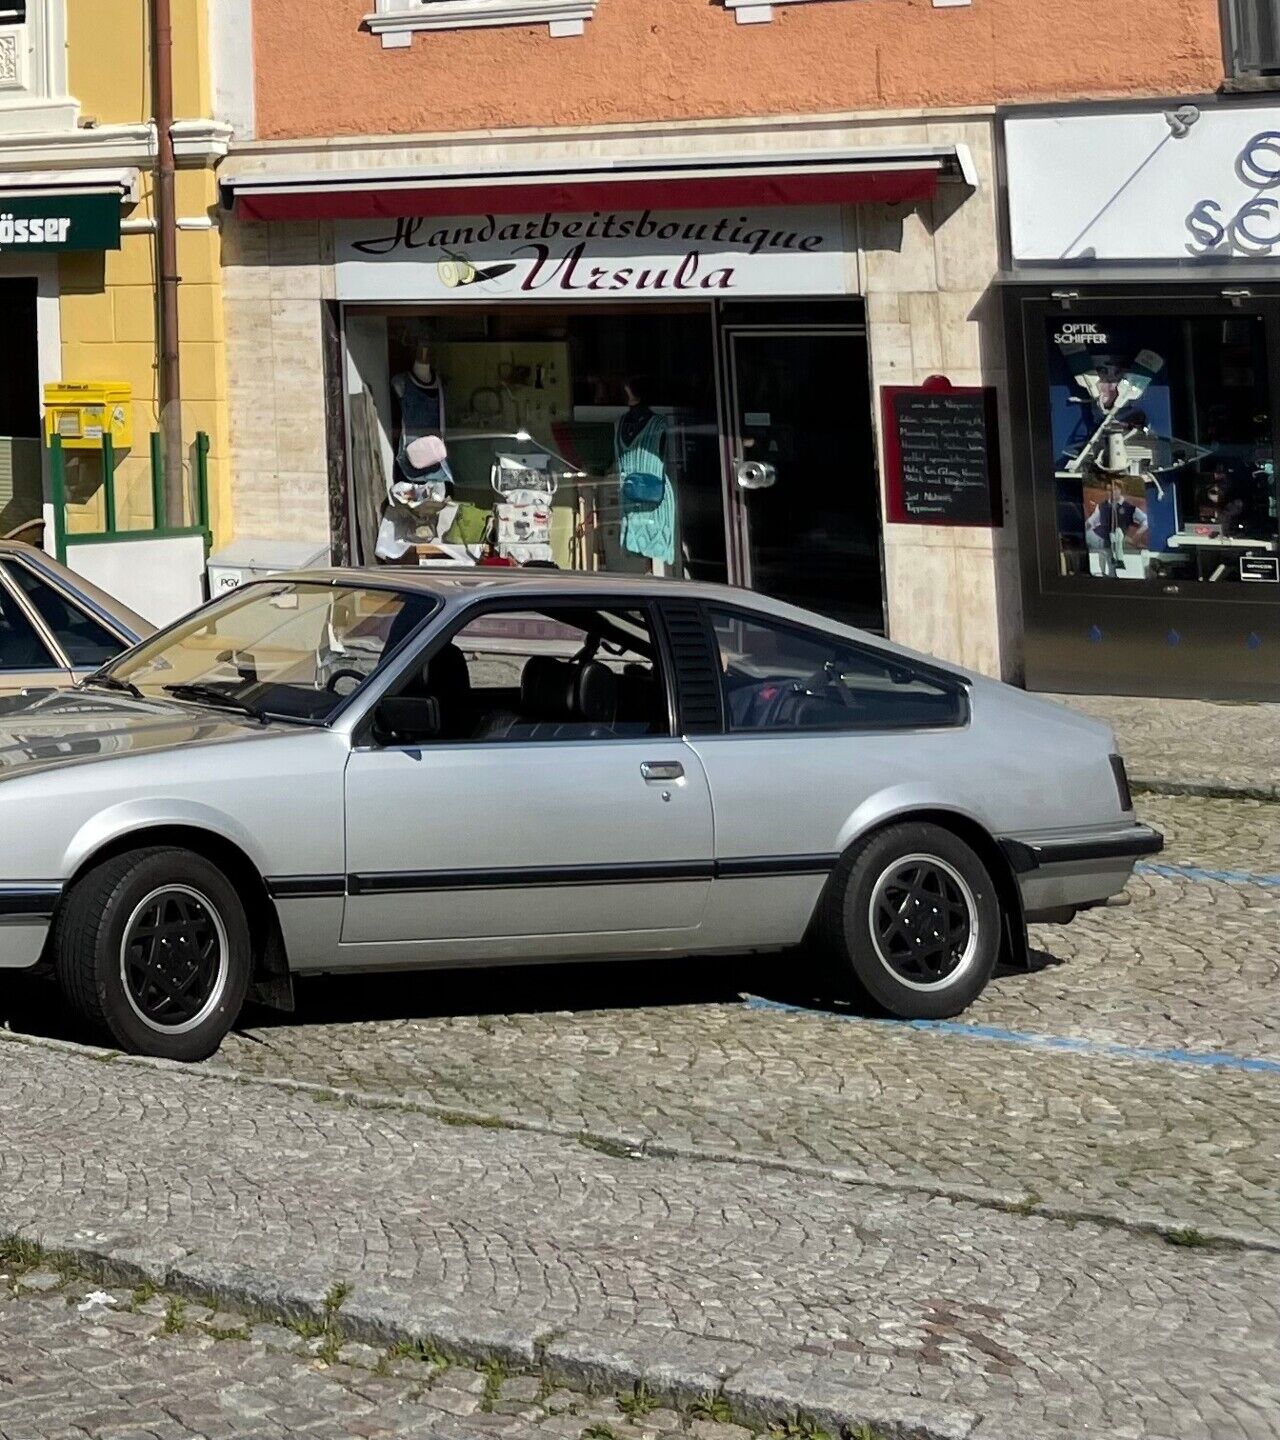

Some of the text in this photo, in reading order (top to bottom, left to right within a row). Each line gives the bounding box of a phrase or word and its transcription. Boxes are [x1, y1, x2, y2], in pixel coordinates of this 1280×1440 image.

[350, 210, 826, 255] Handarbeitsboutique
[511, 241, 737, 291] Ursula
[1053, 333, 1108, 344] SCHIFFER
[1062, 323, 1097, 334] OPTIK
